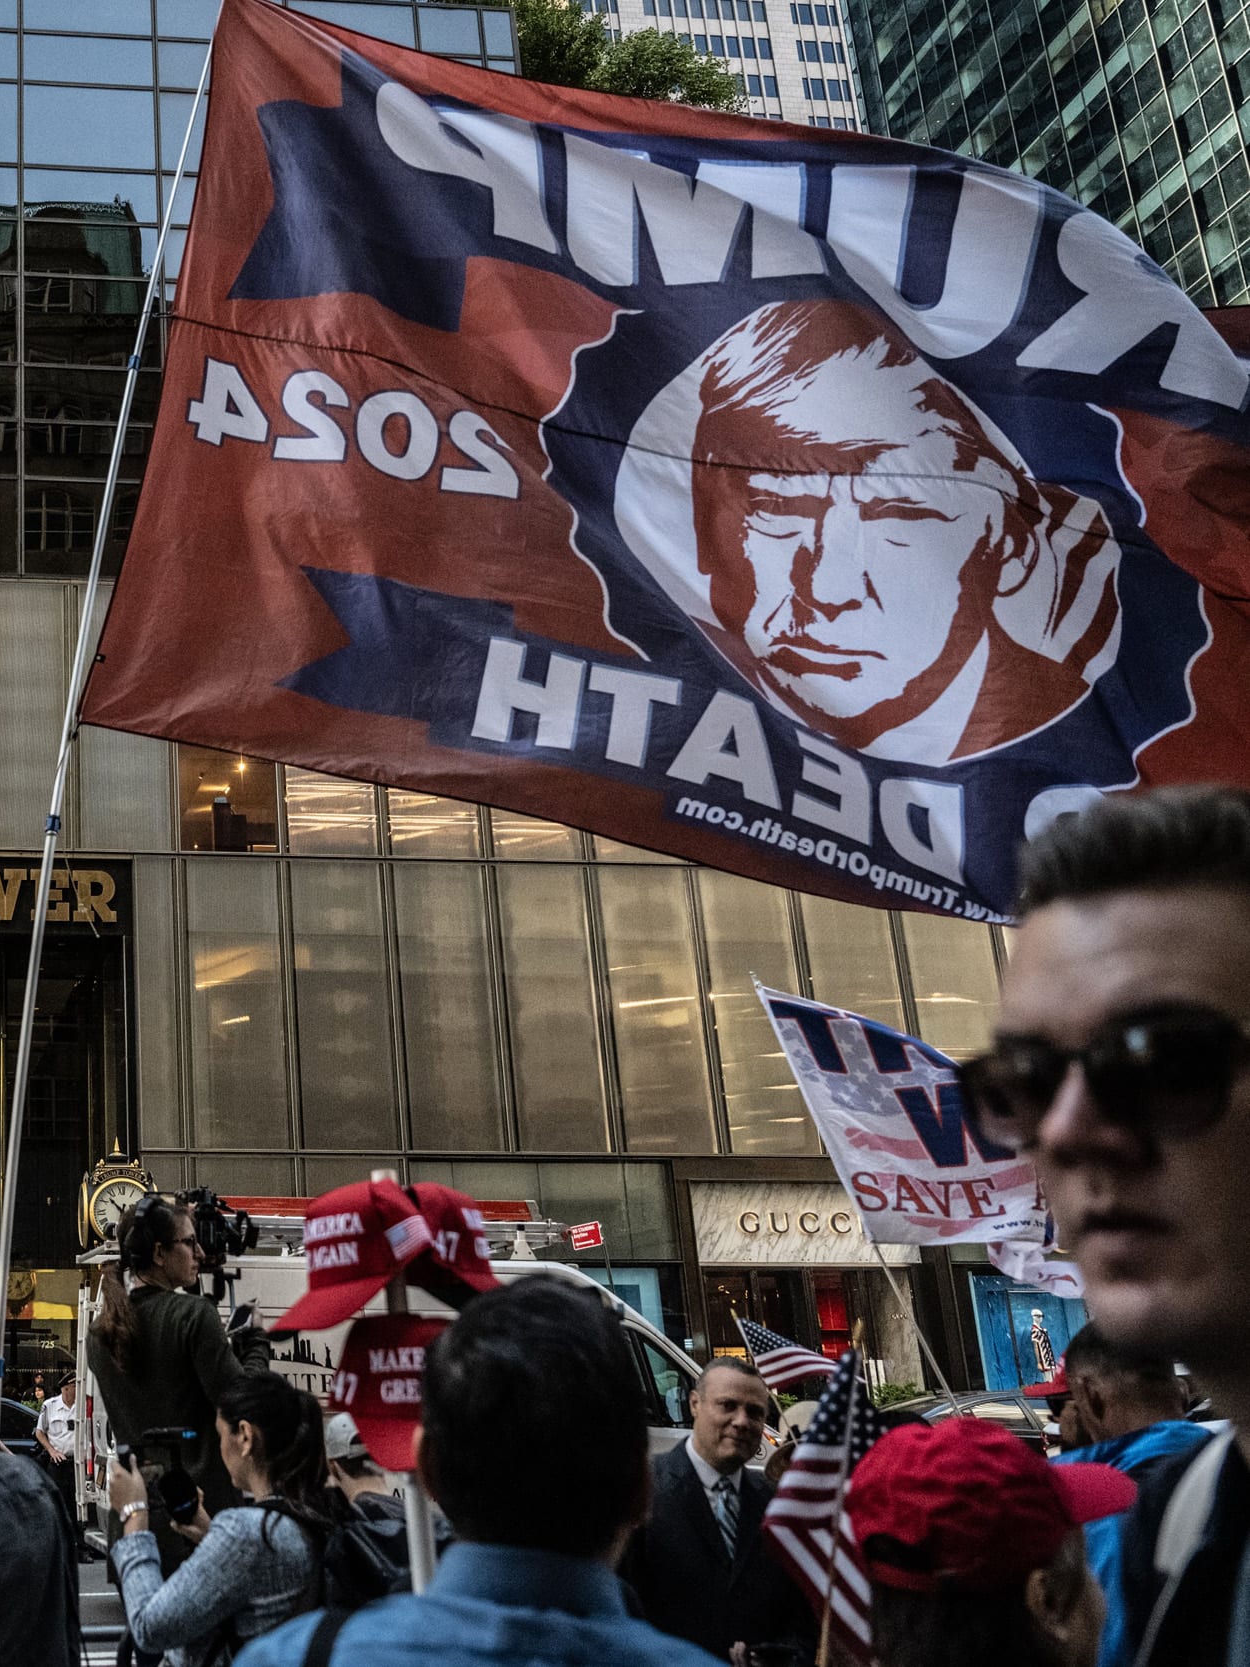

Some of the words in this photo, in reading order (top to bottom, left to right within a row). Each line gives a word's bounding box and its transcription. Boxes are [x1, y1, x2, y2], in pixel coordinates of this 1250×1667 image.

[851, 1171, 1006, 1219] SAVE
[737, 1211, 862, 1235] GUCC
[433, 1229, 460, 1262] 47
[40, 1340, 55, 1349] 725
[332, 1370, 358, 1405] 47
[379, 1378, 424, 1404] GRE
